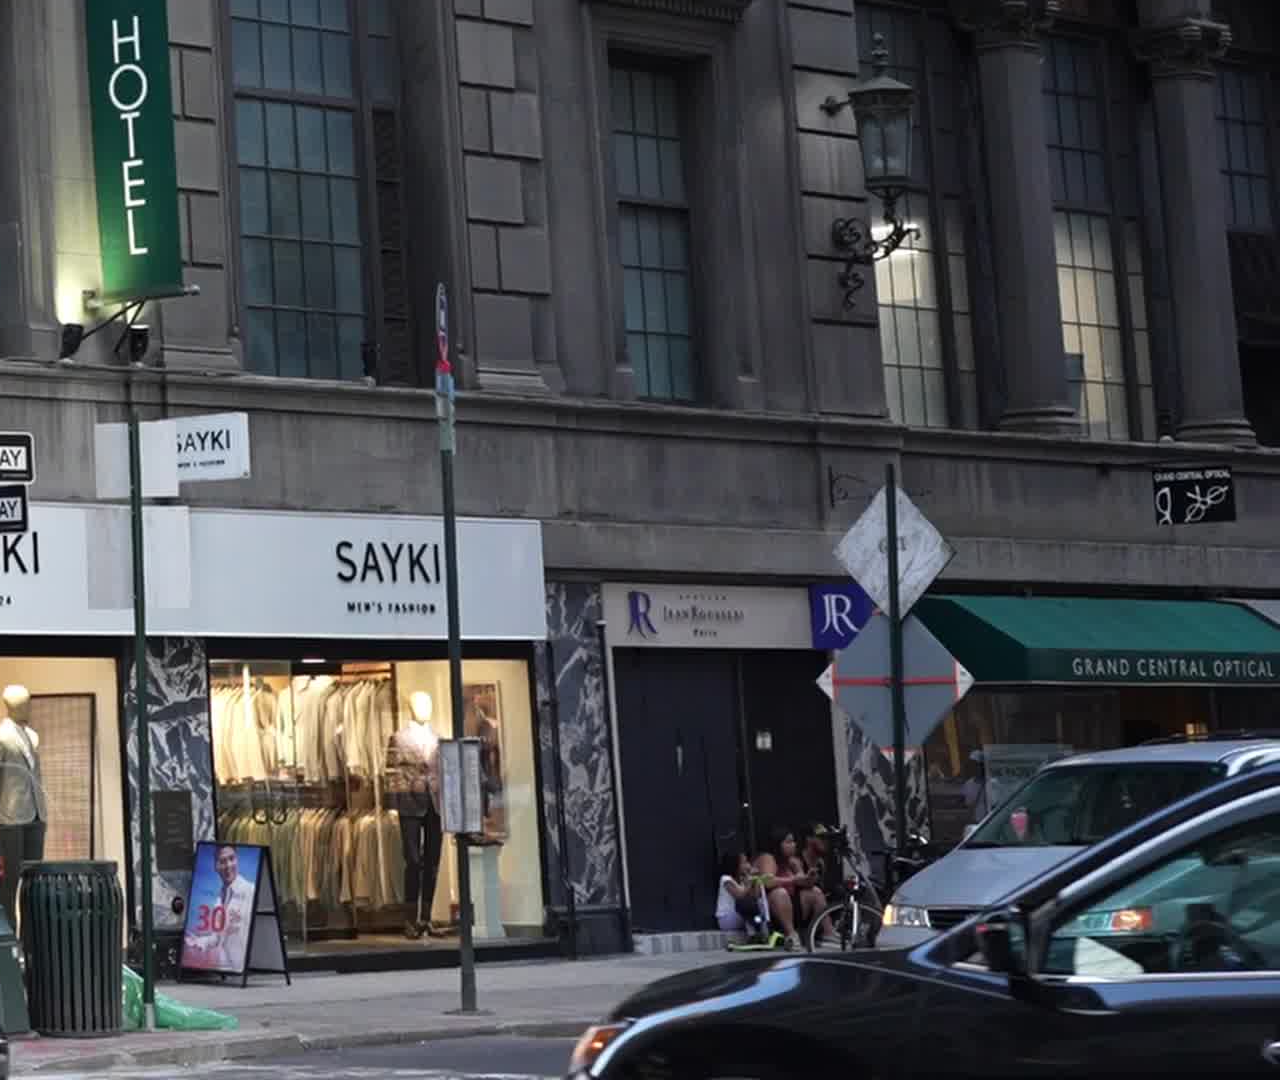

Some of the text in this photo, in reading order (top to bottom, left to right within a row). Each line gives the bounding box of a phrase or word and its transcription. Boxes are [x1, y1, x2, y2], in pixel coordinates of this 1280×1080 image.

[109, 16, 148, 255] HOTEL
[336, 540, 441, 584] SAYKI
[346, 601, 436, 615] MEN'S FASHION
[1071, 657, 1275, 677] GRAND CENTRAL OPTICAL
